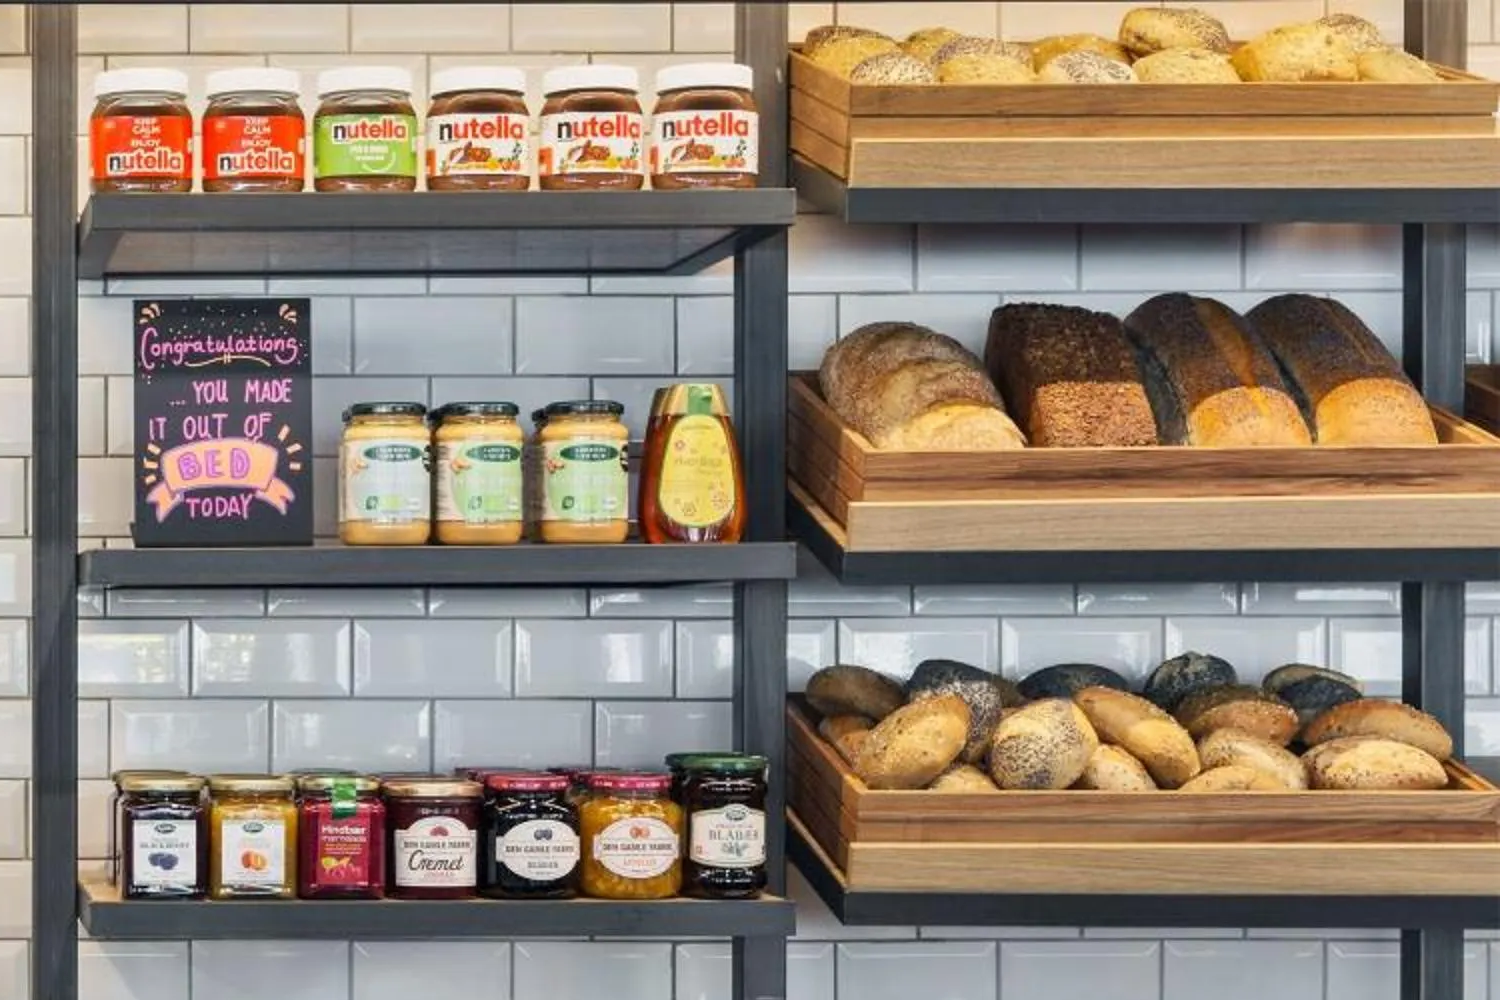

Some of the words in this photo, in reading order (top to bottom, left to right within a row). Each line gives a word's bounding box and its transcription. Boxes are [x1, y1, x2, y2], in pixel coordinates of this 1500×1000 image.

[333, 119, 408, 140] nutella
[439, 115, 525, 141] nutella
[557, 114, 641, 140] nutella
[662, 112, 749, 139] nutella
[108, 149, 183, 172] nutella
[219, 149, 294, 172] nutella
[140, 327, 299, 370] Congratulations
[244, 379, 293, 403] MADE
[148, 416, 168, 441] IT
[182, 413, 229, 440] OUT
[243, 412, 273, 438] OF
[176, 447, 251, 481] BED
[185, 494, 253, 520] TODAY
